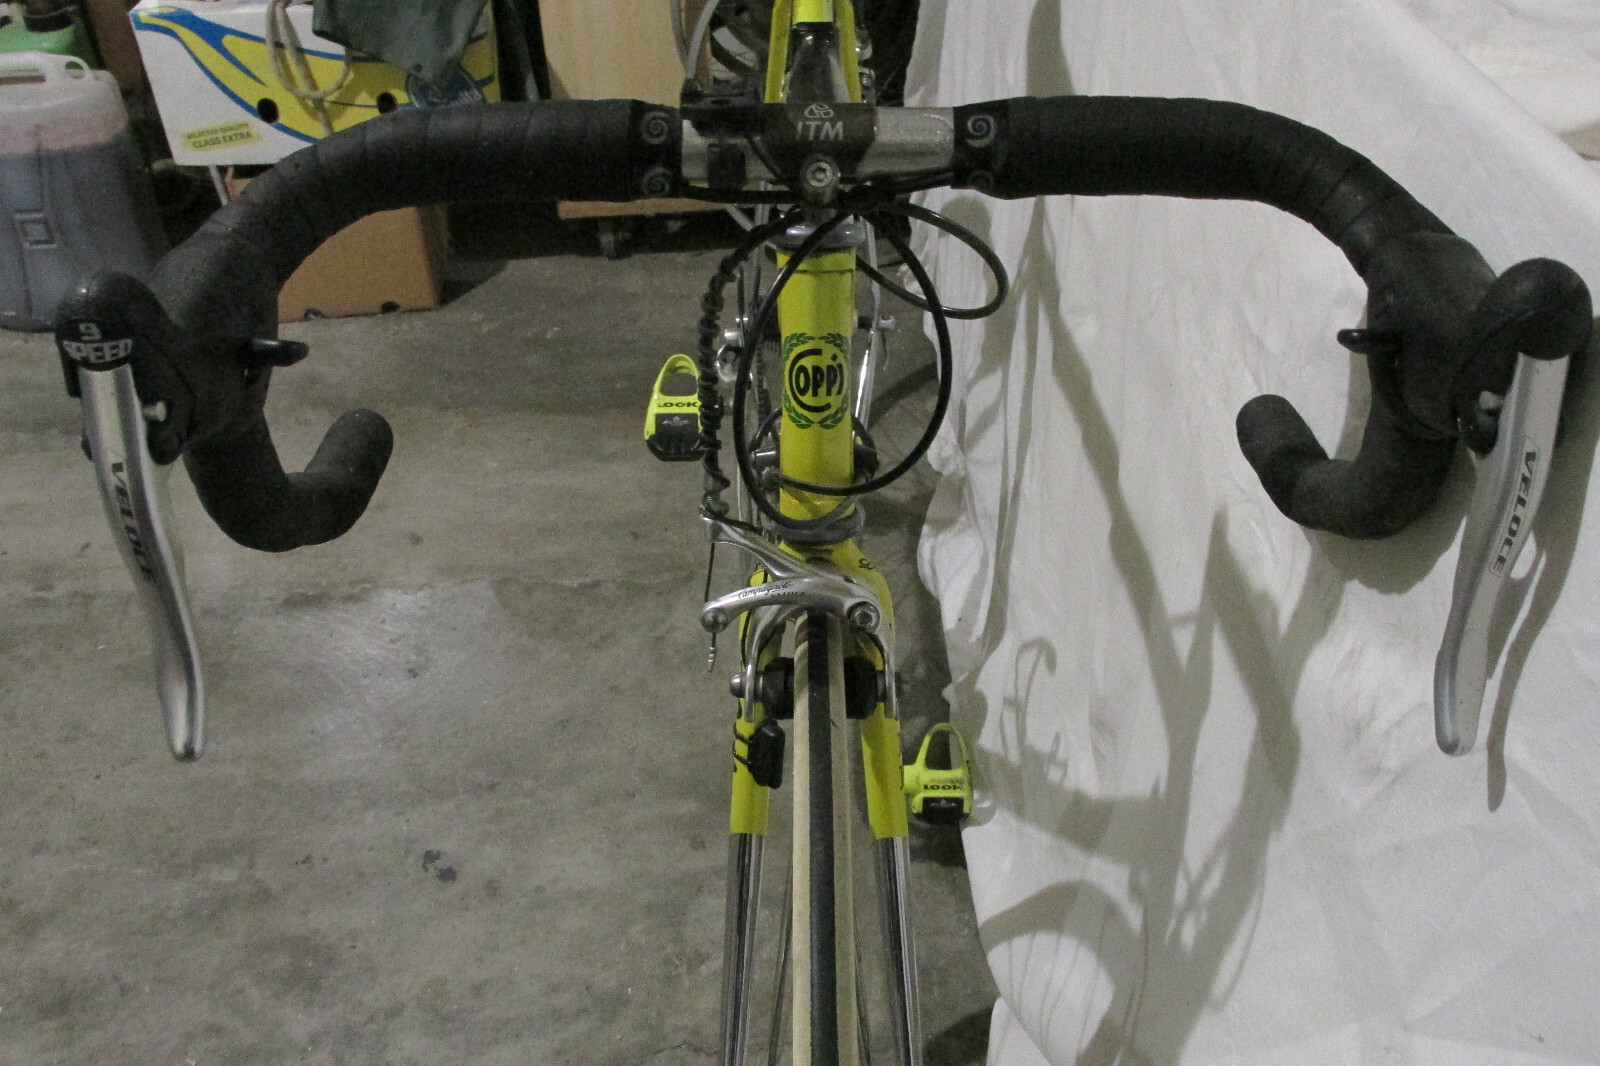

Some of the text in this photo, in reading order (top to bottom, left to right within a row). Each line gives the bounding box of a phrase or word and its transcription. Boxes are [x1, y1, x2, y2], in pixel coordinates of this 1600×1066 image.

[192, 131, 253, 149] CLASS EXTRA
[795, 121, 843, 141] ITM
[78, 322, 101, 341] 9
[62, 338, 134, 363] SPEED
[1493, 451, 1537, 573] VELOCE
